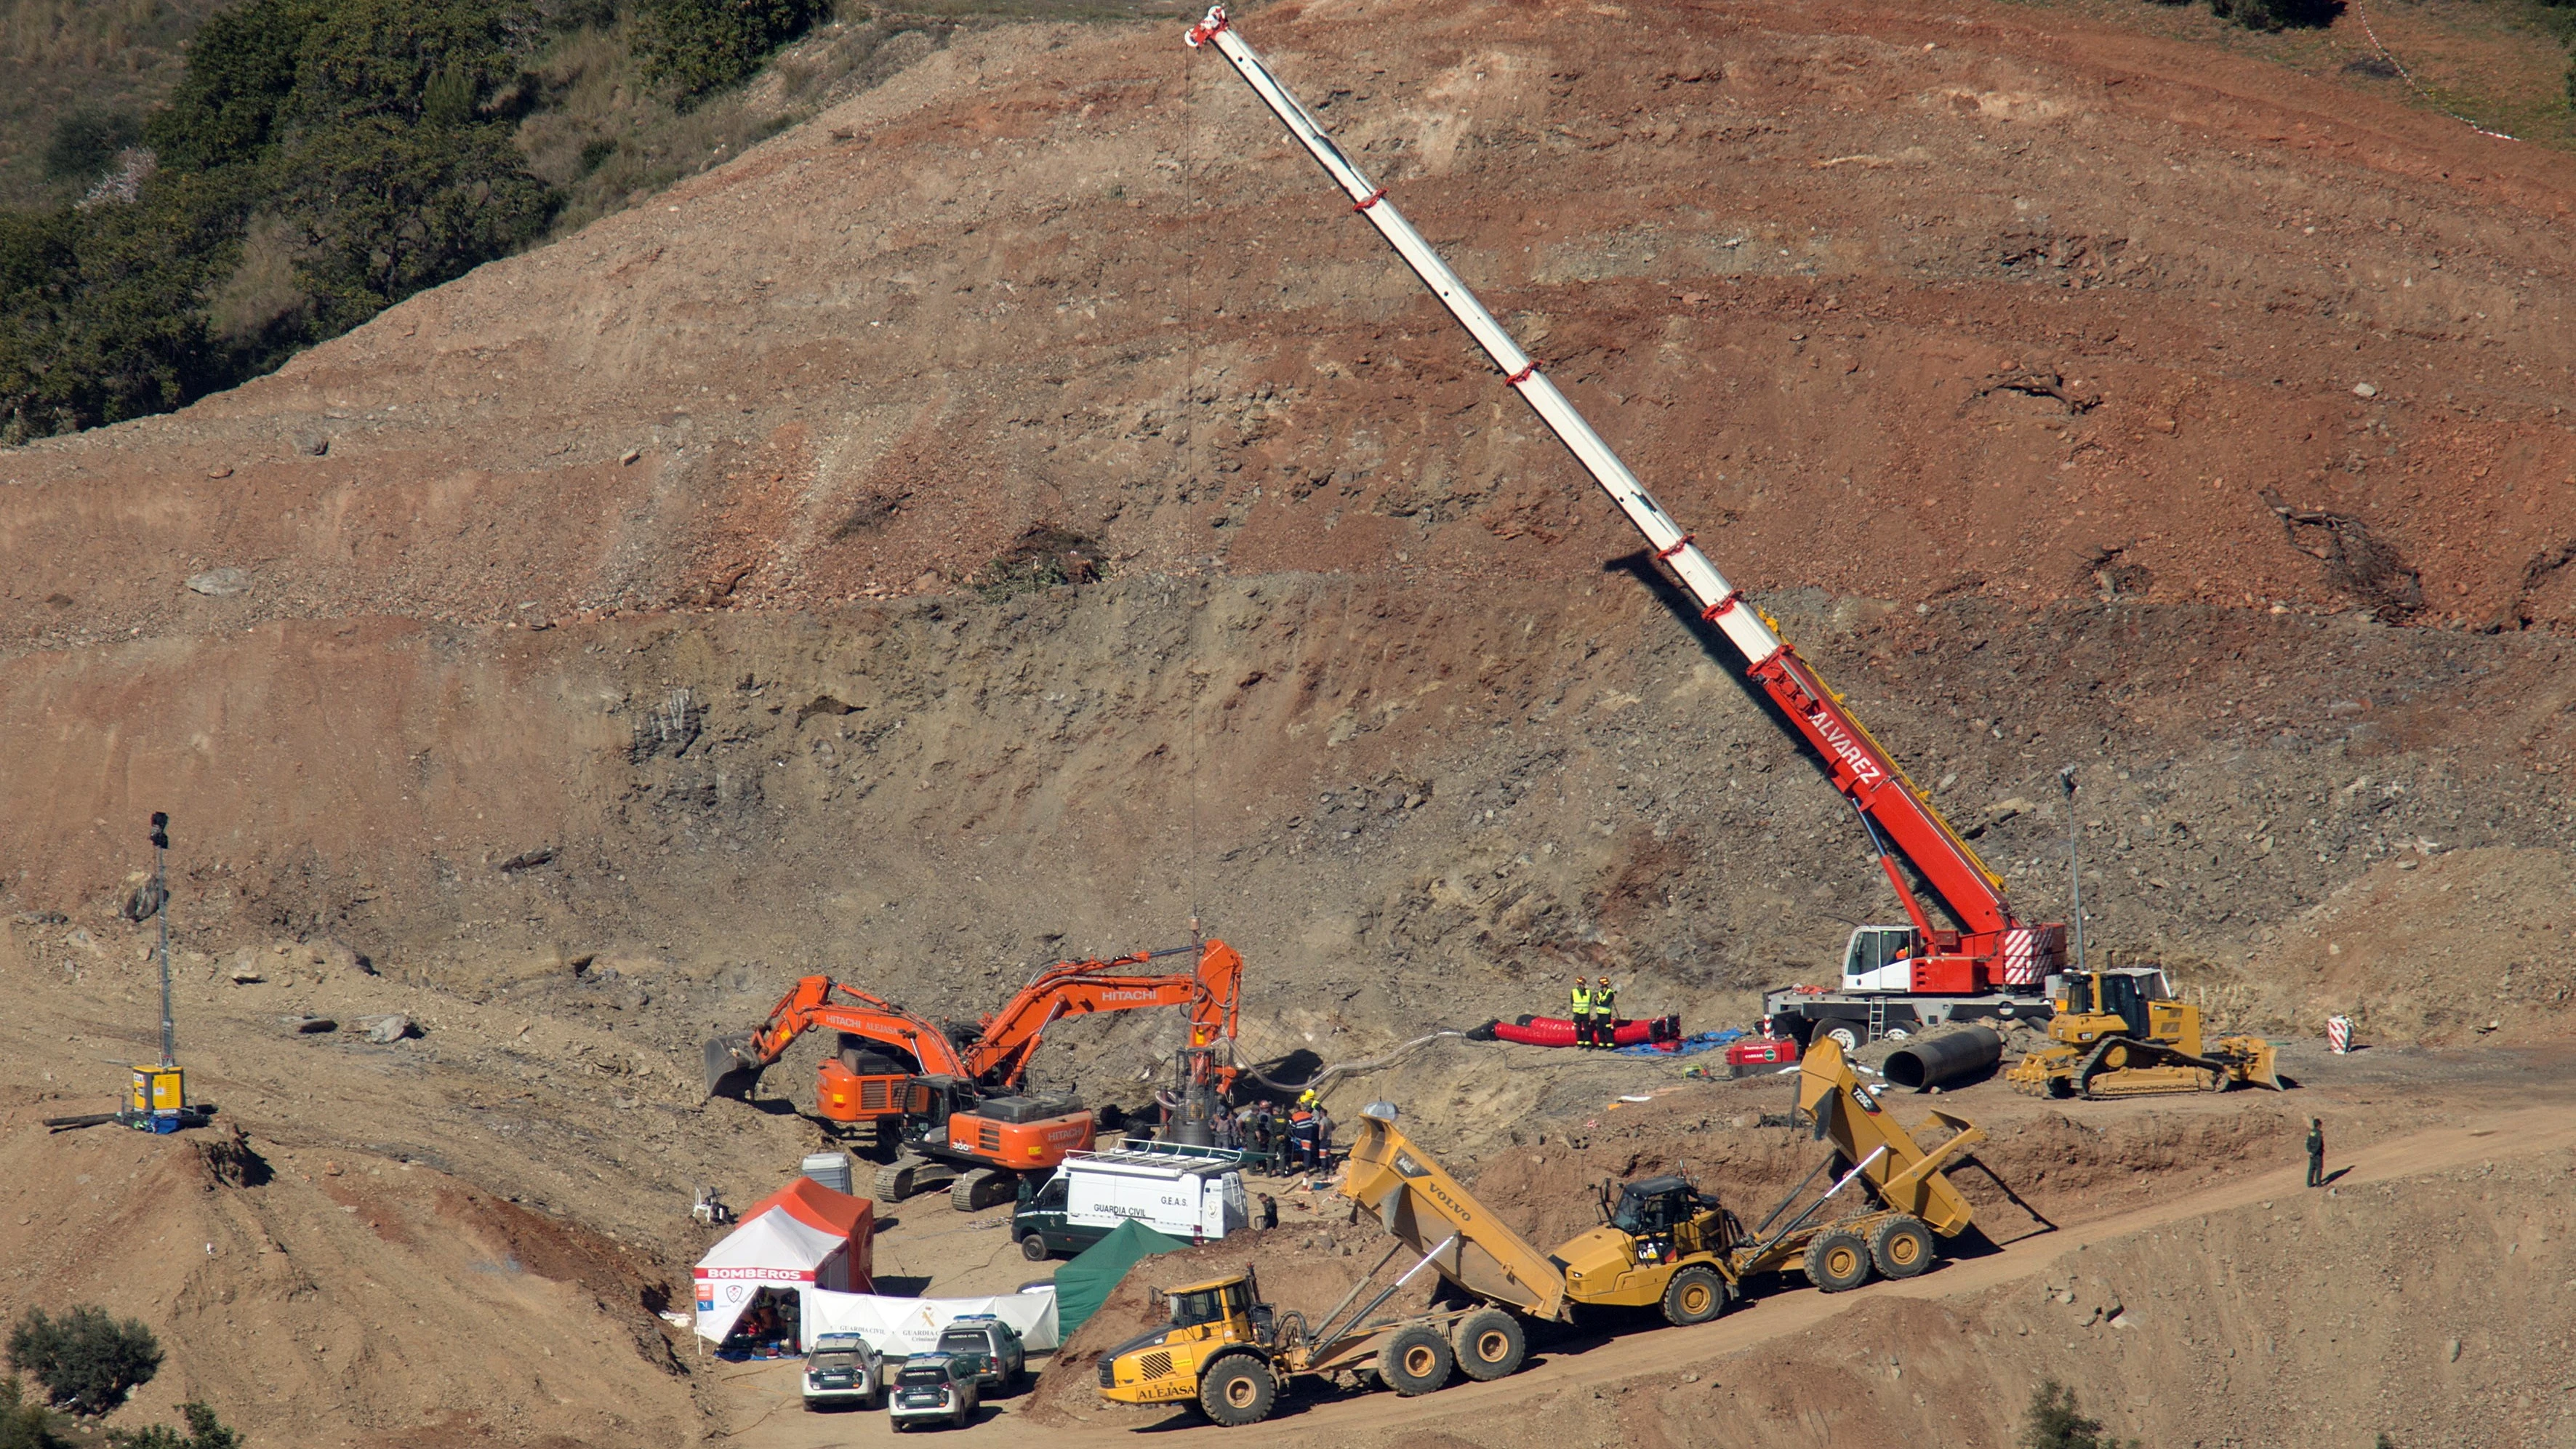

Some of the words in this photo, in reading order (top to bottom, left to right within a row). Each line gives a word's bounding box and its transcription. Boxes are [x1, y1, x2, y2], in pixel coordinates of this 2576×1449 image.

[1807, 712, 1880, 784] ALVAREZ
[1102, 990, 1157, 1001] HITACHI
[826, 1014, 861, 1028] HITACHI
[865, 1022, 898, 1035] ALEJASA
[1853, 1088, 1871, 1108] 725C
[1048, 1127, 1083, 1141] HITACHI
[952, 1141, 969, 1152] 300
[1160, 1196, 1188, 1207] G.E.A.S.
[1429, 1181, 1472, 1221] VOLVO
[1094, 1203, 1126, 1214] GUARDIA
[1128, 1207, 1146, 1217] CIVIL
[707, 1269, 801, 1280] BOMBEROS
[1138, 1385, 1195, 1400] ALEJASA
